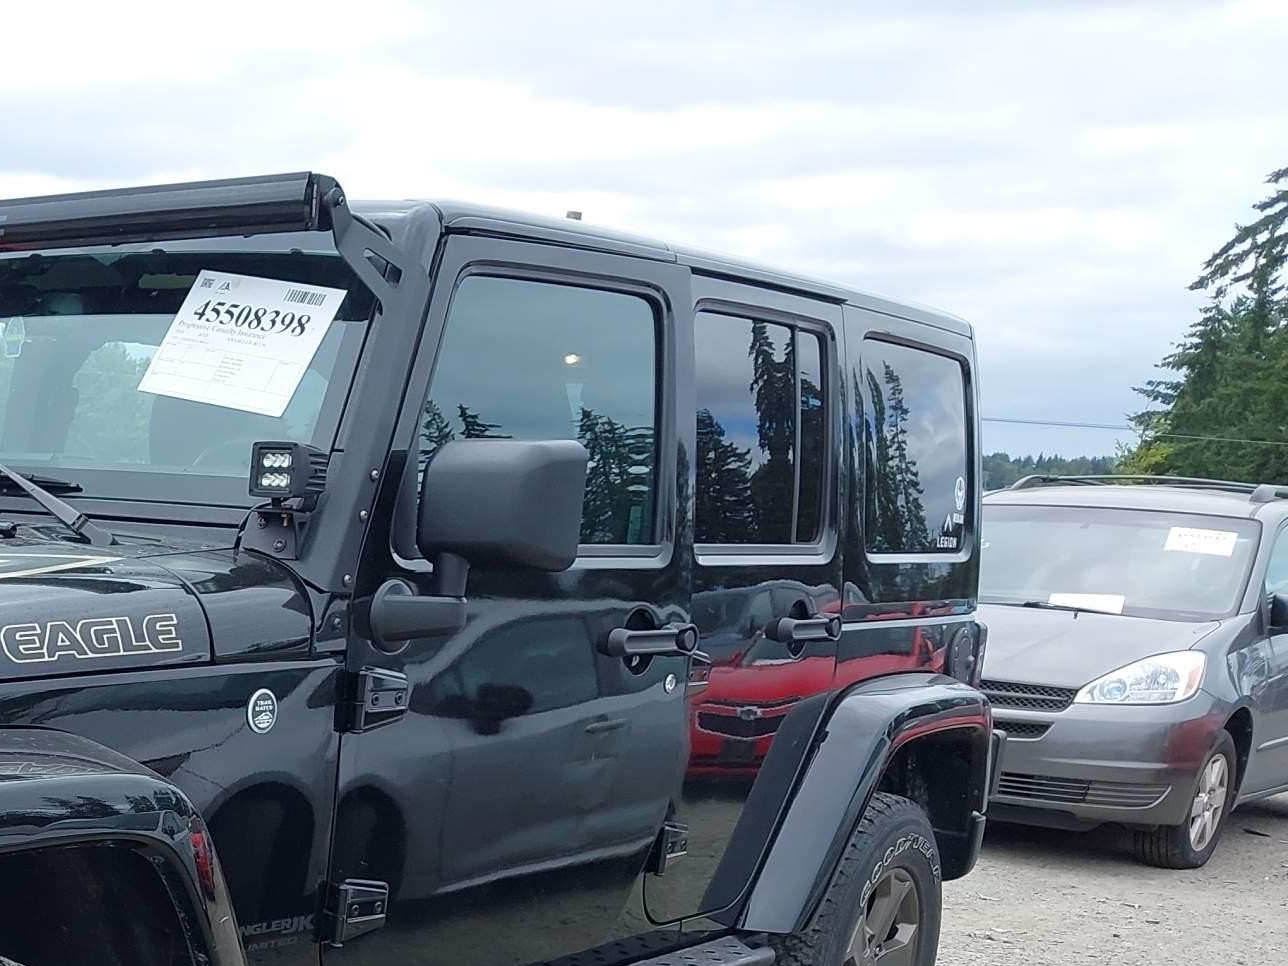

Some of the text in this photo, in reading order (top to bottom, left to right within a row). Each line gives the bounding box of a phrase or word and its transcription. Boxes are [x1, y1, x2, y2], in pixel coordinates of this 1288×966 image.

[194, 300, 311, 337] 45508398
[937, 536, 958, 548] LEGION
[0, 613, 183, 664] EAGLE
